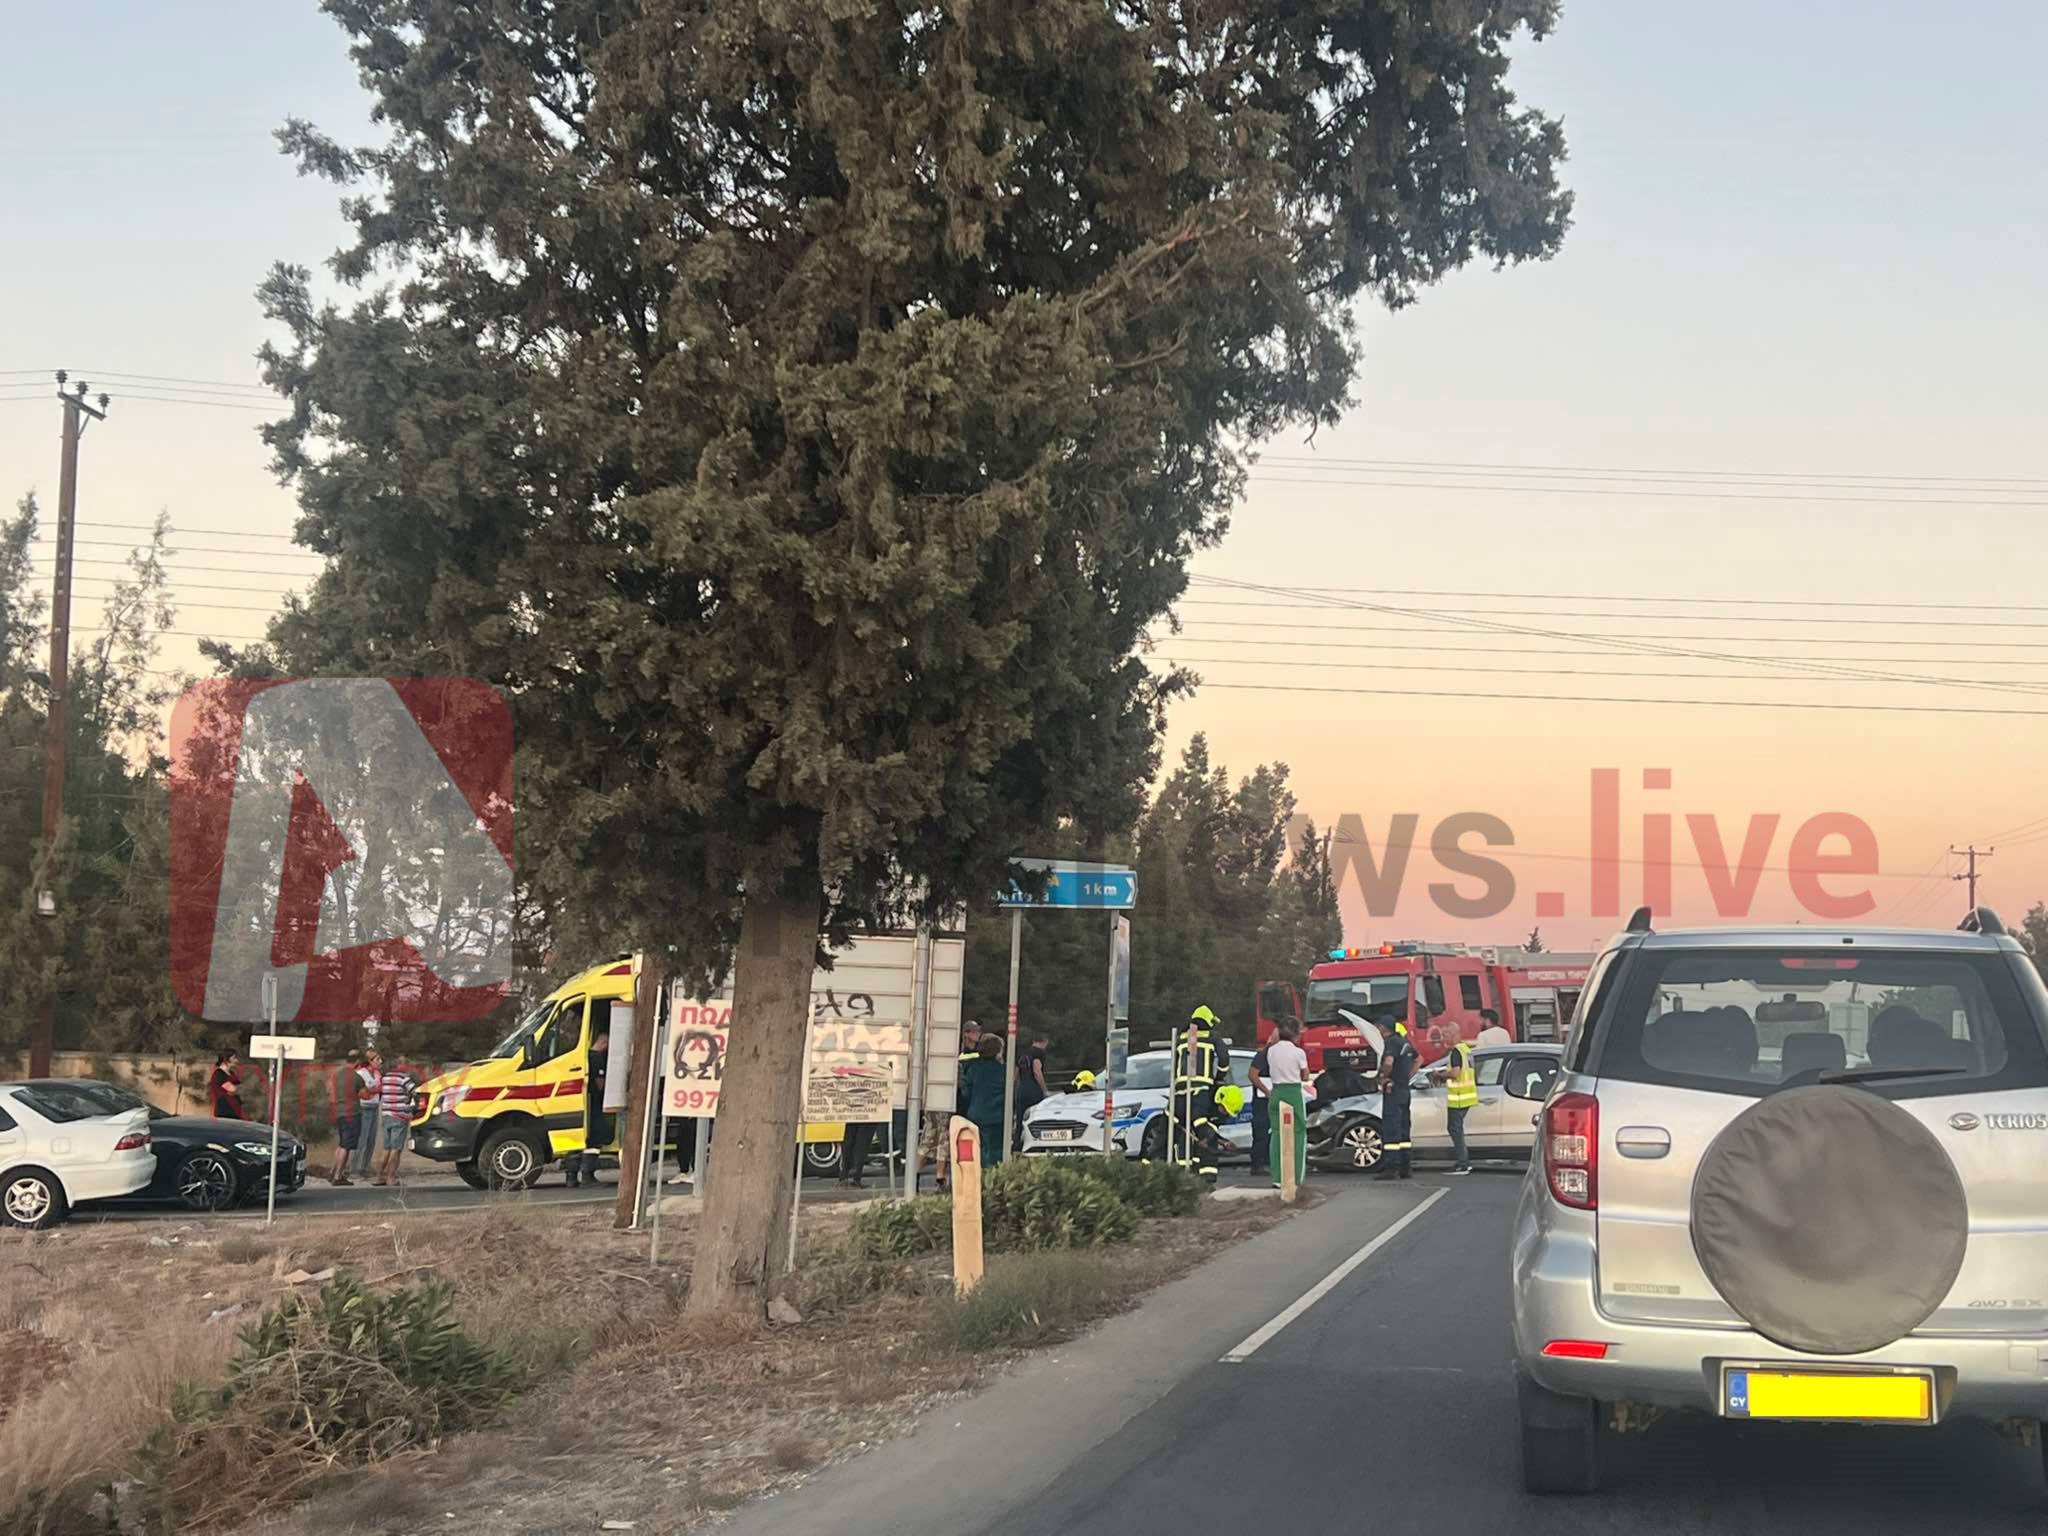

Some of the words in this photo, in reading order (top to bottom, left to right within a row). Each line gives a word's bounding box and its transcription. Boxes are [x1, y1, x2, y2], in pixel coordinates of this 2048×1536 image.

[1340, 1049, 1368, 1058] MAN
[1984, 1112, 2048, 1129] TERIOS
[1730, 1396, 1746, 1407] CY
